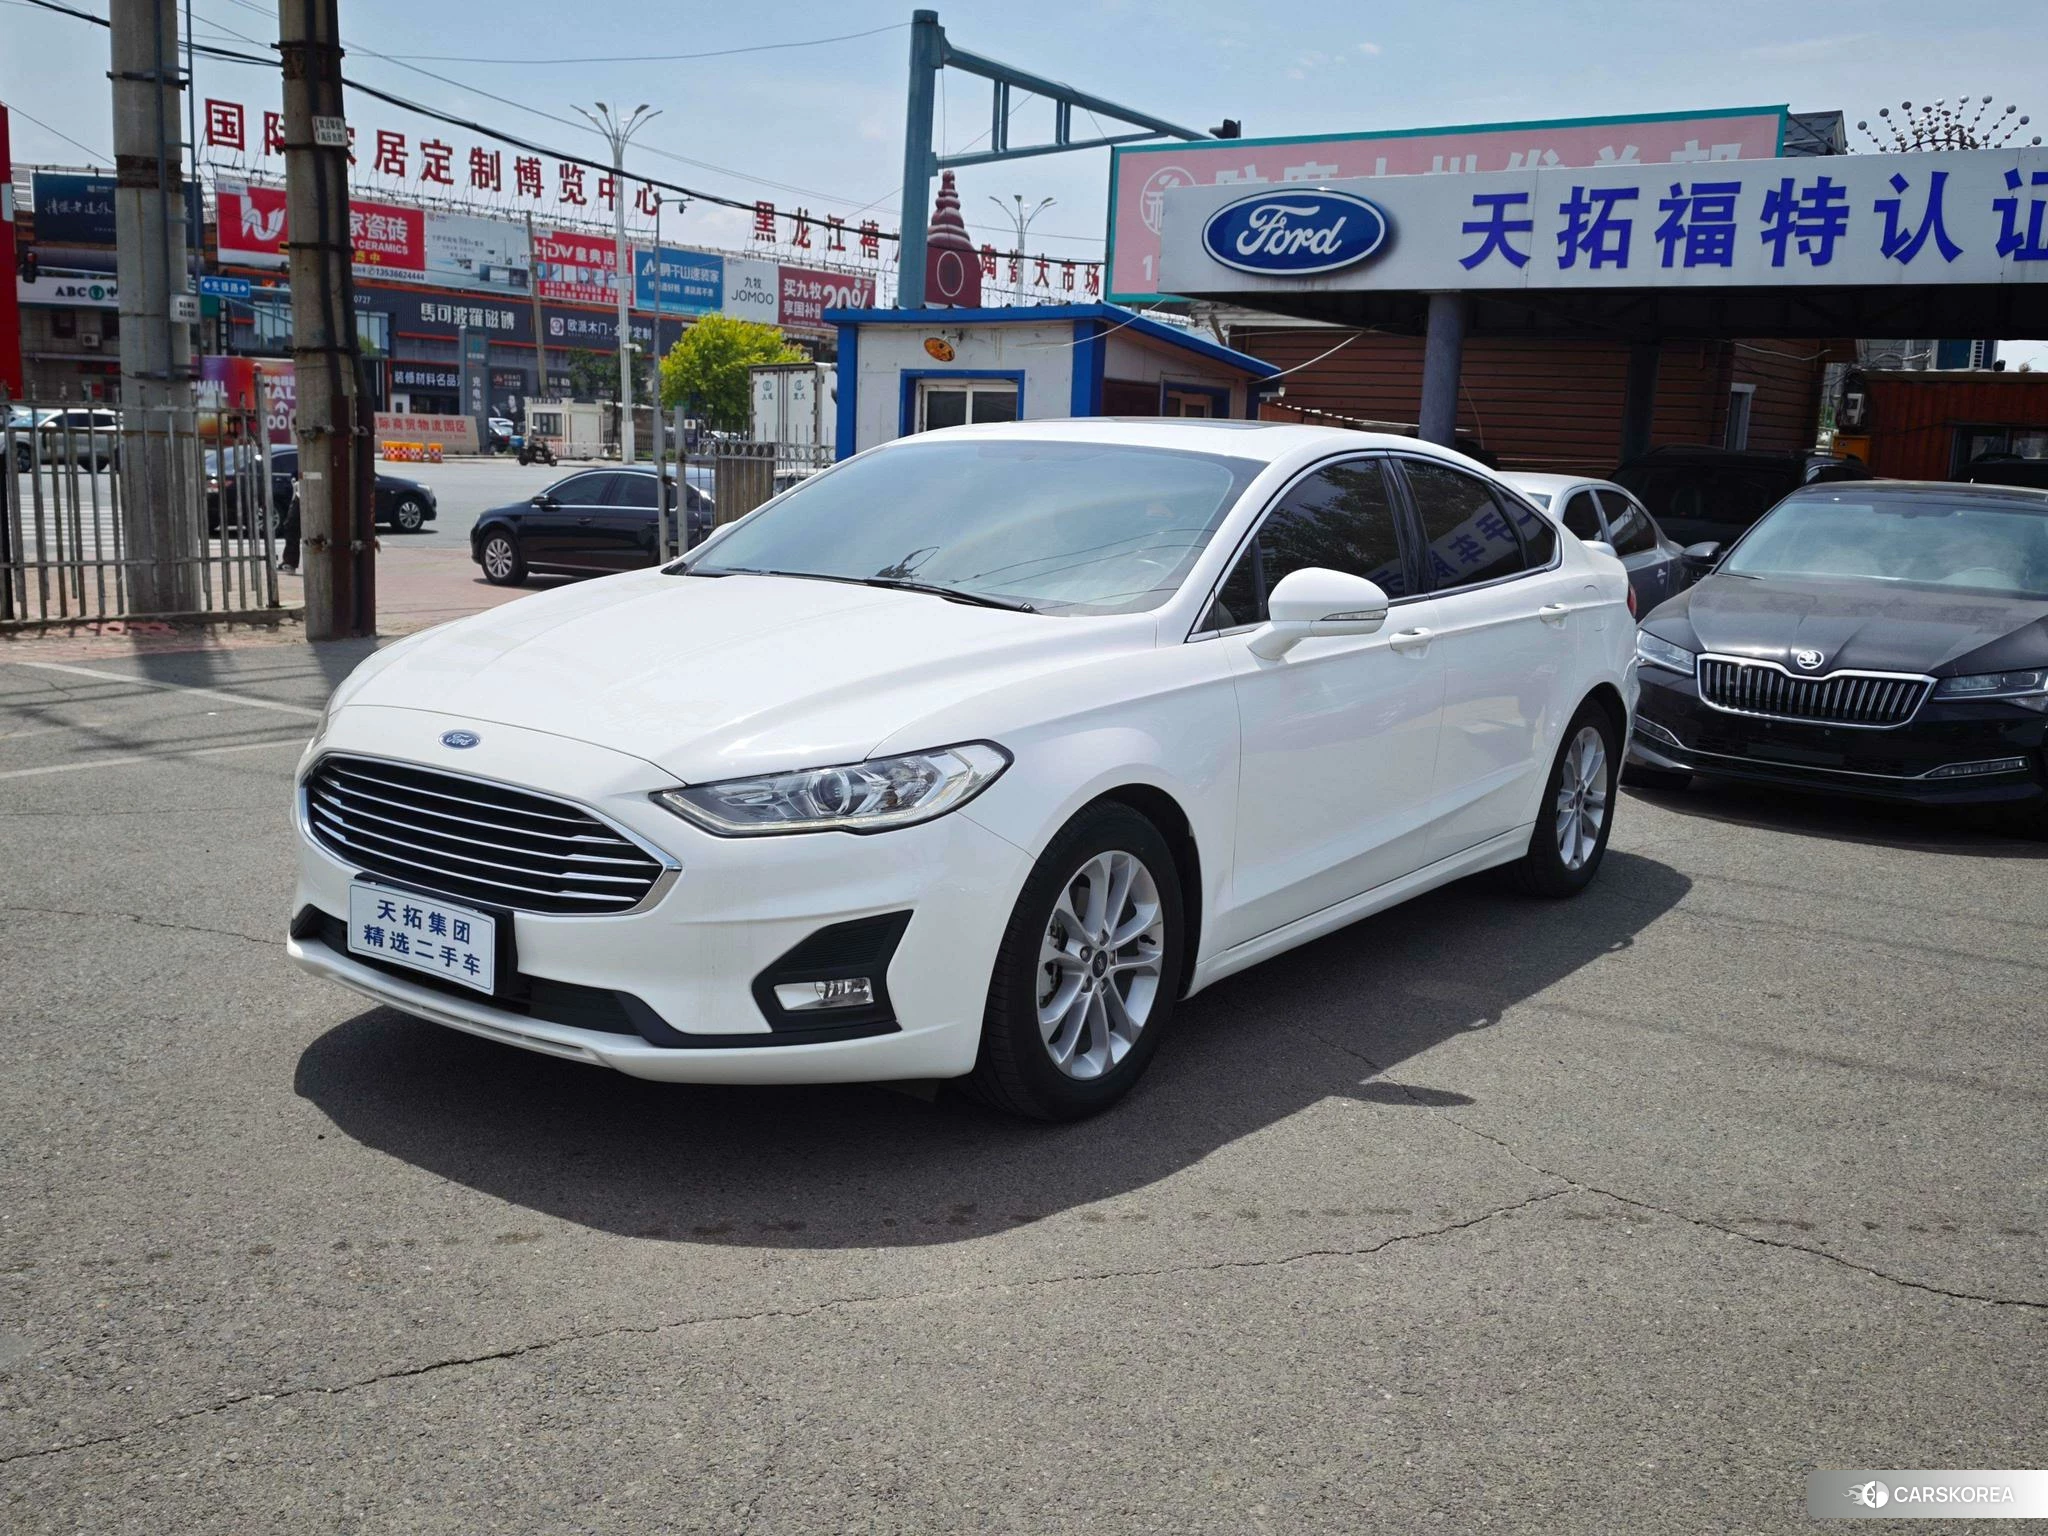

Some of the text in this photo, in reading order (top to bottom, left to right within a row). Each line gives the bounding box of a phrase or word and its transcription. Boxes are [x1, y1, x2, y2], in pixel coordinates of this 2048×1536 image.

[205, 98, 658, 216] 国际居定制博览中心
[1236, 203, 1348, 257] Ford
[1459, 167, 2048, 270] 天拓福特认证
[358, 239, 409, 255] CERAMICS
[55, 286, 87, 297] ABC
[731, 289, 774, 305] JOMOO
[745, 277, 762, 289] 九牧
[784, 278, 822, 301] 买九牧
[376, 899, 471, 944] 天拓集团
[363, 924, 481, 976] 精选二手车
